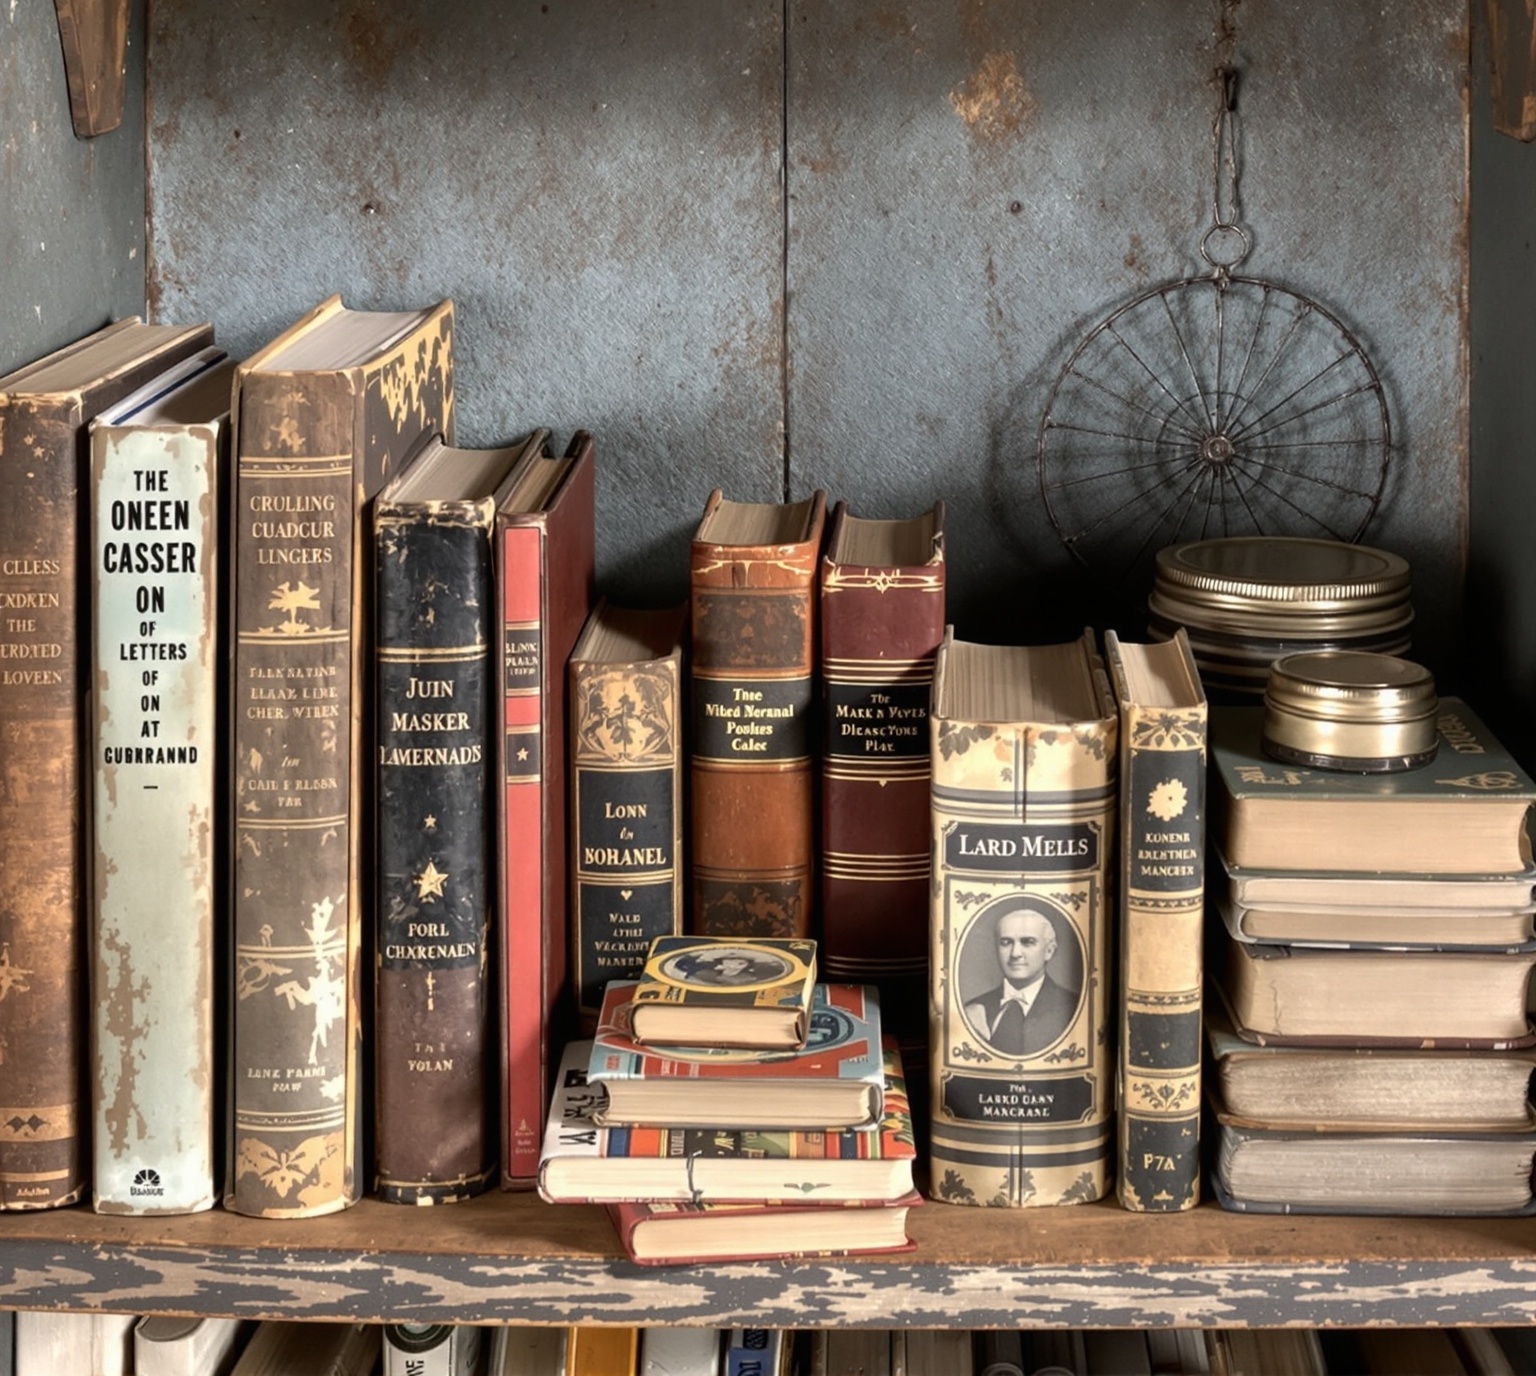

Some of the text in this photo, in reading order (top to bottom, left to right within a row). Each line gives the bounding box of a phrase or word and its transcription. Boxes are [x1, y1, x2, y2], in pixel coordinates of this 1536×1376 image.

[133, 470, 168, 491] THE
[111, 500, 189, 531] ONEEN
[103, 542, 196, 573] CASSER
[136, 585, 164, 613] ON
[6, 619, 36, 632] THE
[139, 621, 156, 636] OF
[120, 643, 187, 661] LETTERS
[142, 671, 158, 686] OF
[406, 677, 455, 699] JUIN
[141, 695, 160, 712] ON
[141, 721, 160, 737] AT
[391, 712, 471, 732] MASKER
[605, 802, 647, 819] LONN
[959, 833, 1089, 857] LARD MELLS
